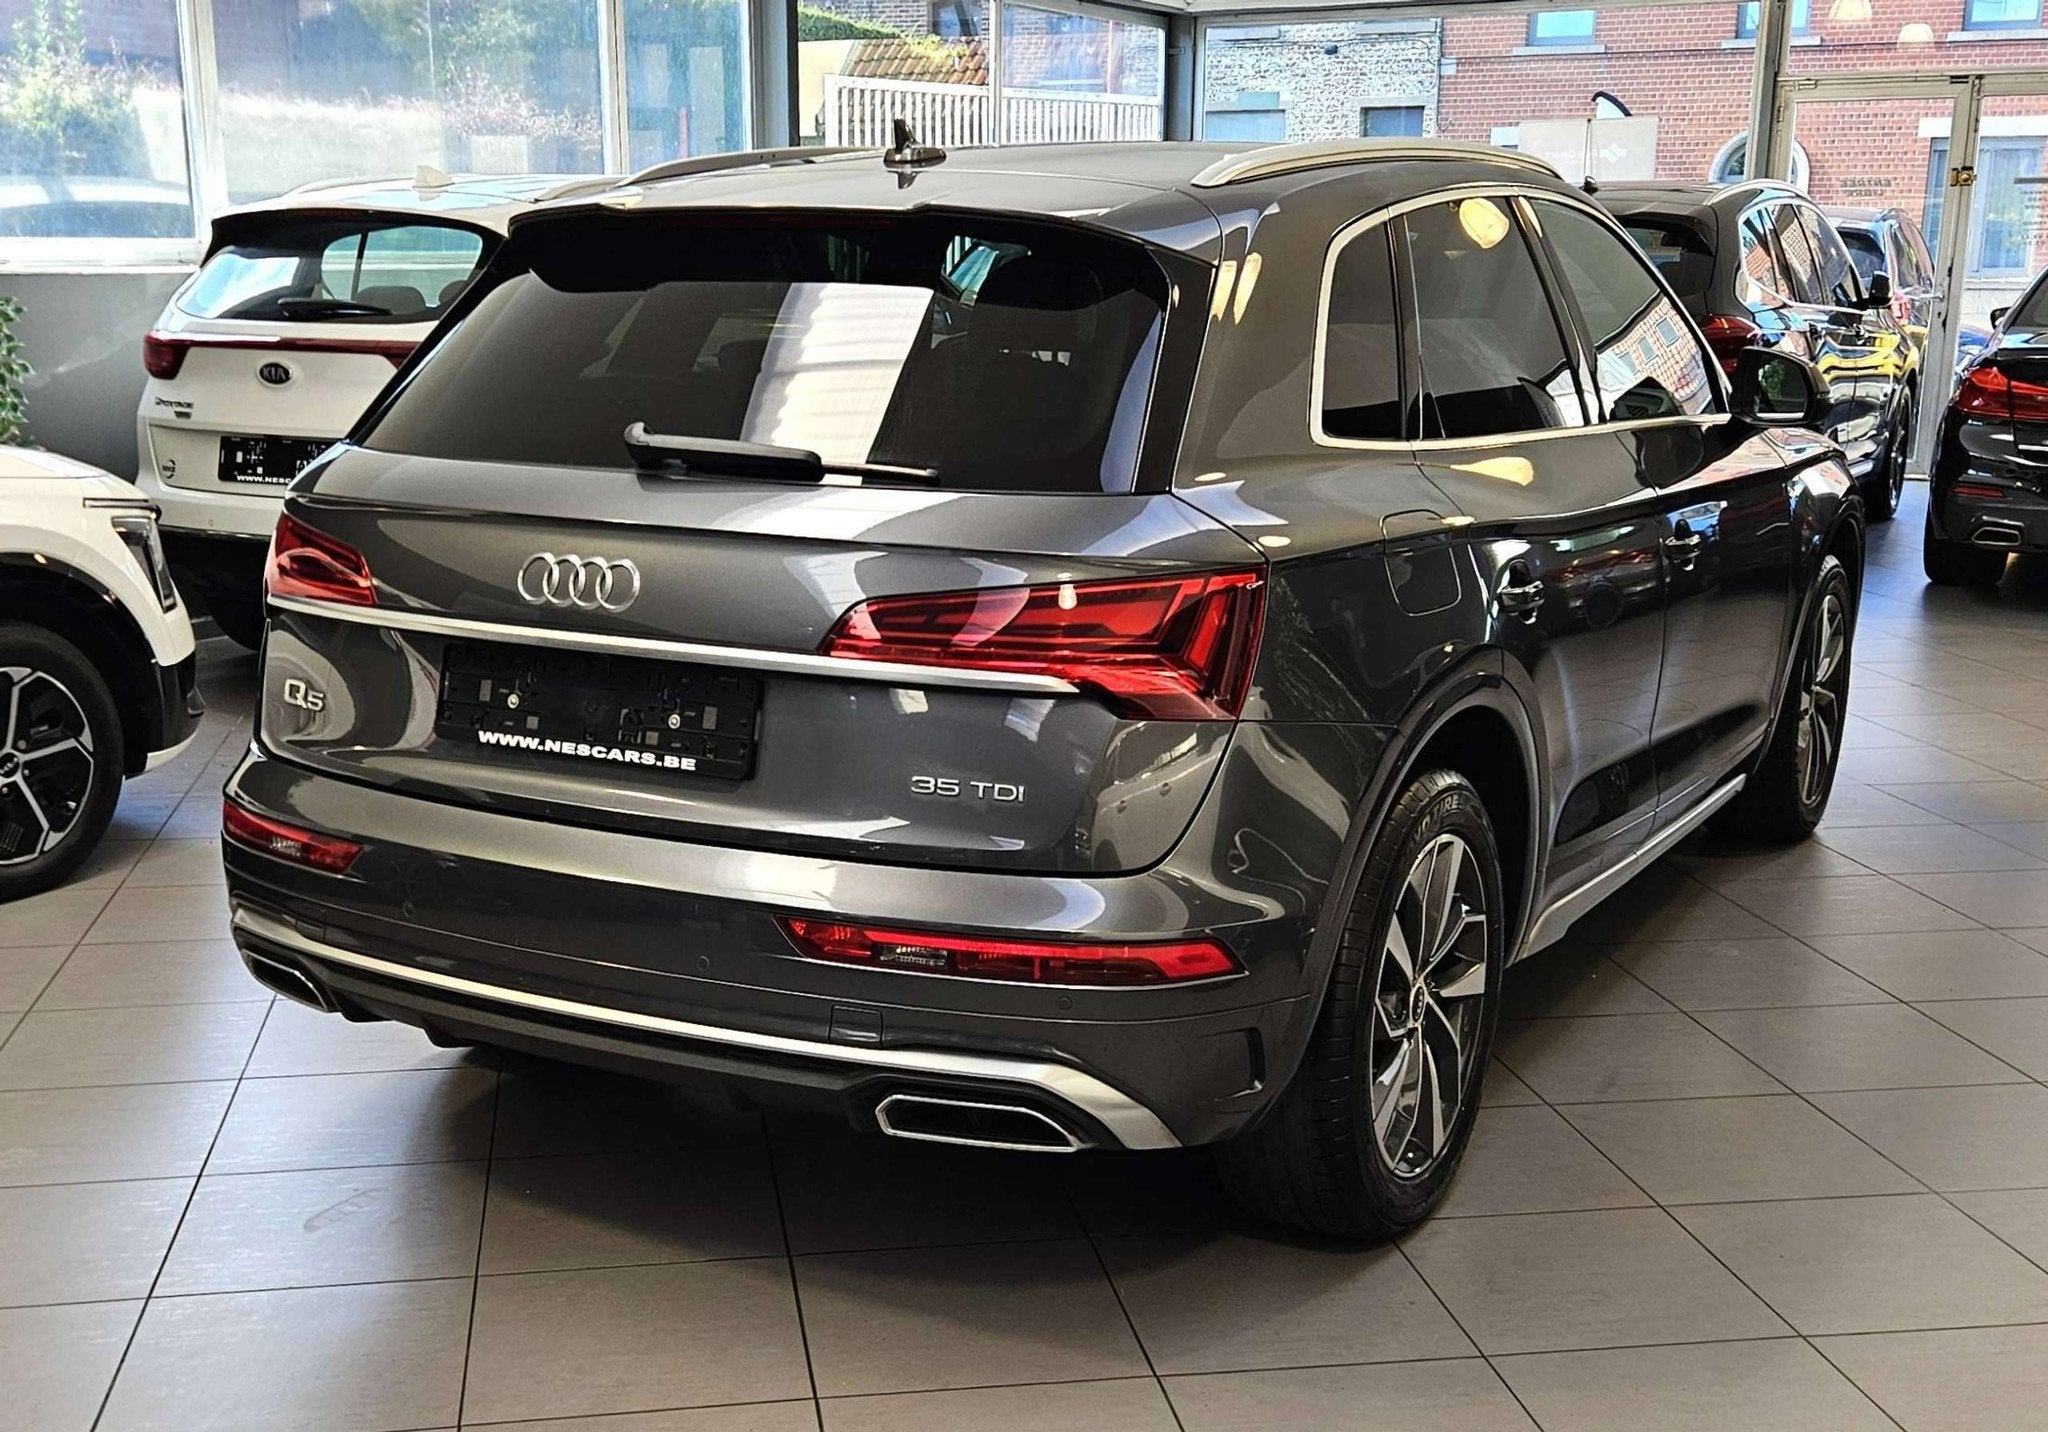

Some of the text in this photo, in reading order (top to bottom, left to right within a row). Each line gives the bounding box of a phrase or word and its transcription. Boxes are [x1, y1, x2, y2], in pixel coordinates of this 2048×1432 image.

[262, 366, 286, 381] KIA
[284, 678, 324, 711] Q5
[478, 730, 696, 771] WWW.NESCARS.BE
[911, 776, 1025, 802] 35 TDI
